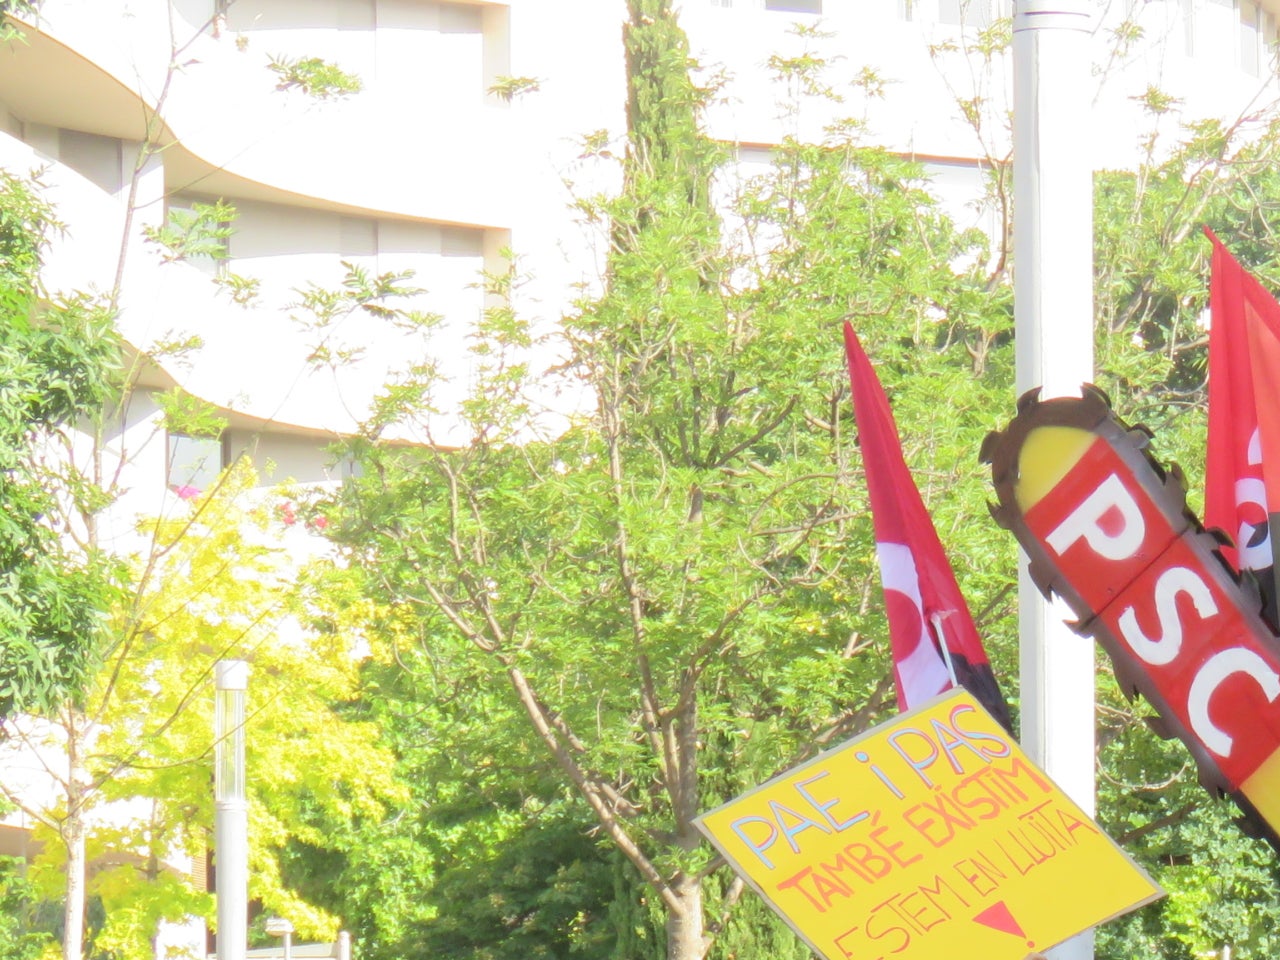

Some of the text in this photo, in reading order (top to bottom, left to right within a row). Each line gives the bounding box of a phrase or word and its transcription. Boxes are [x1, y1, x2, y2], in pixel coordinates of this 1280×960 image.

[730, 770, 870, 870] PAE
[887, 703, 1011, 790] PAS
[777, 810, 923, 912] TAMBÉ
[952, 850, 1005, 898] EN
